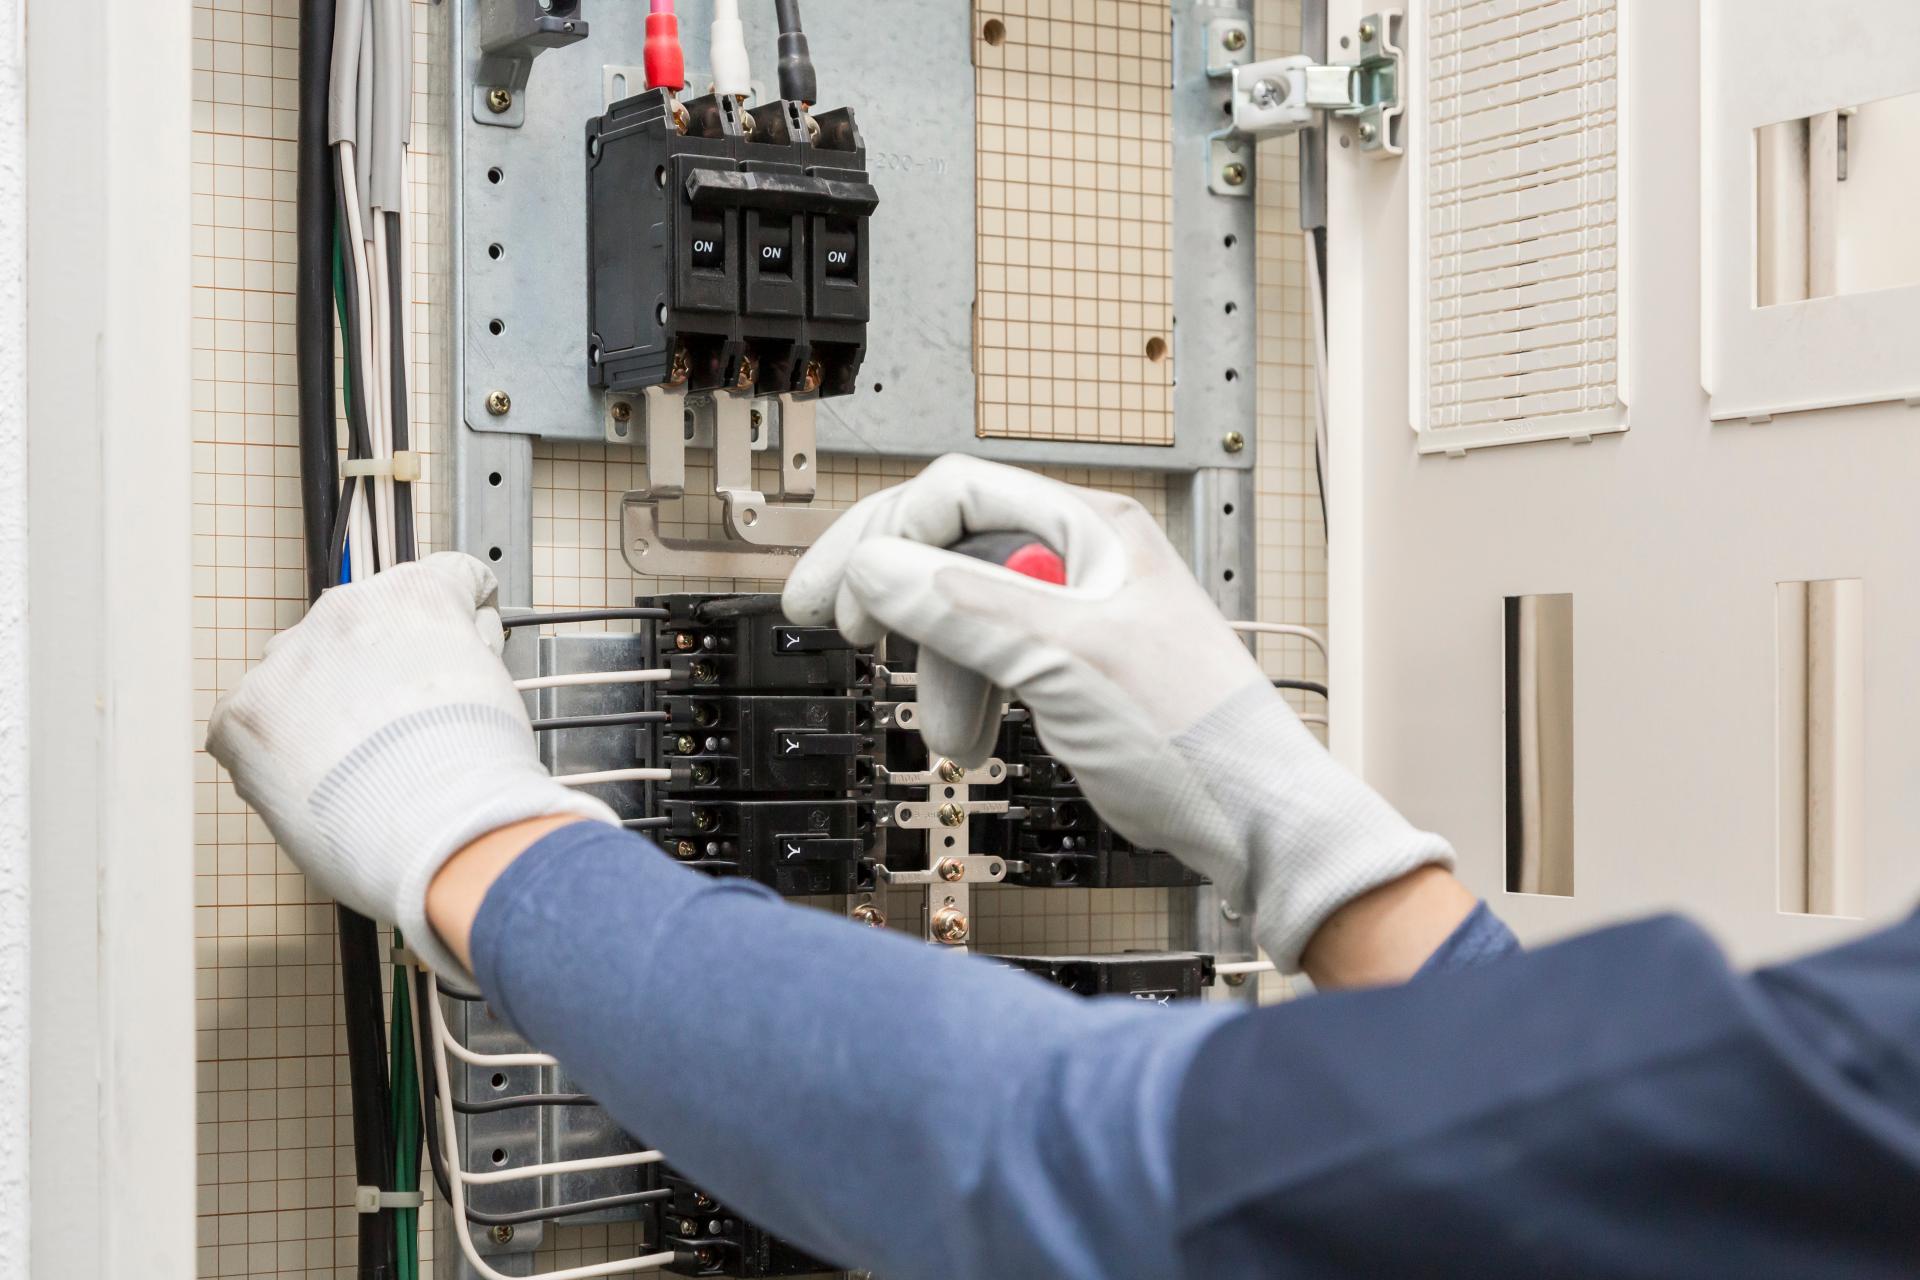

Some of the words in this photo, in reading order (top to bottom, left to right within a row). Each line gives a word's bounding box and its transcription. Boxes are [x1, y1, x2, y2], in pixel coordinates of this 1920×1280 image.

[694, 240, 714, 253] ON
[762, 246, 782, 259] ON
[827, 250, 847, 263] ON
